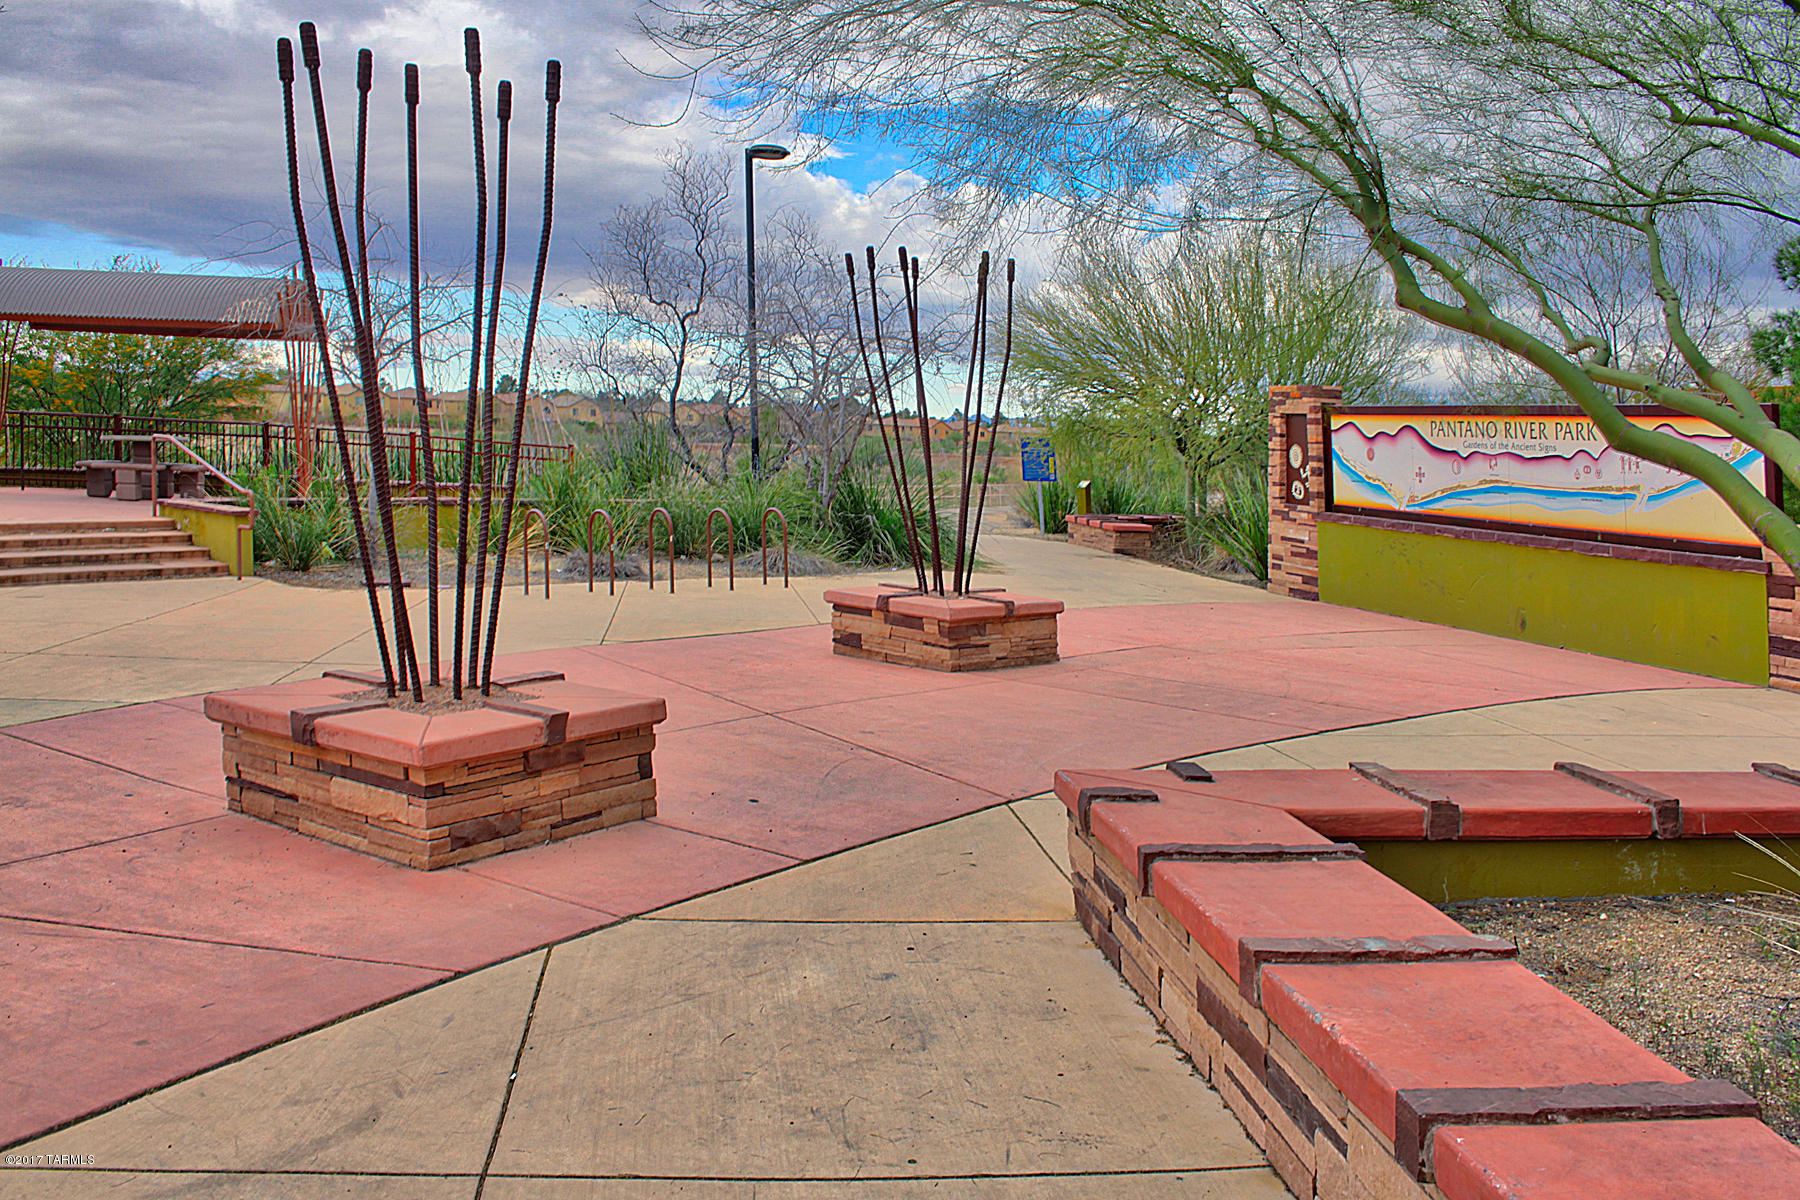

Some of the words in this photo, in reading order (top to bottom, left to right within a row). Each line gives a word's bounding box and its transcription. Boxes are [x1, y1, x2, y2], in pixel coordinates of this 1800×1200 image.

[1430, 420, 1498, 439] PANTANO
[1504, 421, 1549, 440] RIVER
[1555, 422, 1598, 441] PARK
[1462, 440, 1488, 449] Gardens
[1489, 441, 1497, 450] of
[1498, 441, 1509, 450] the
[1511, 442, 1537, 451] Ancient
[1539, 443, 1557, 454] Signs
